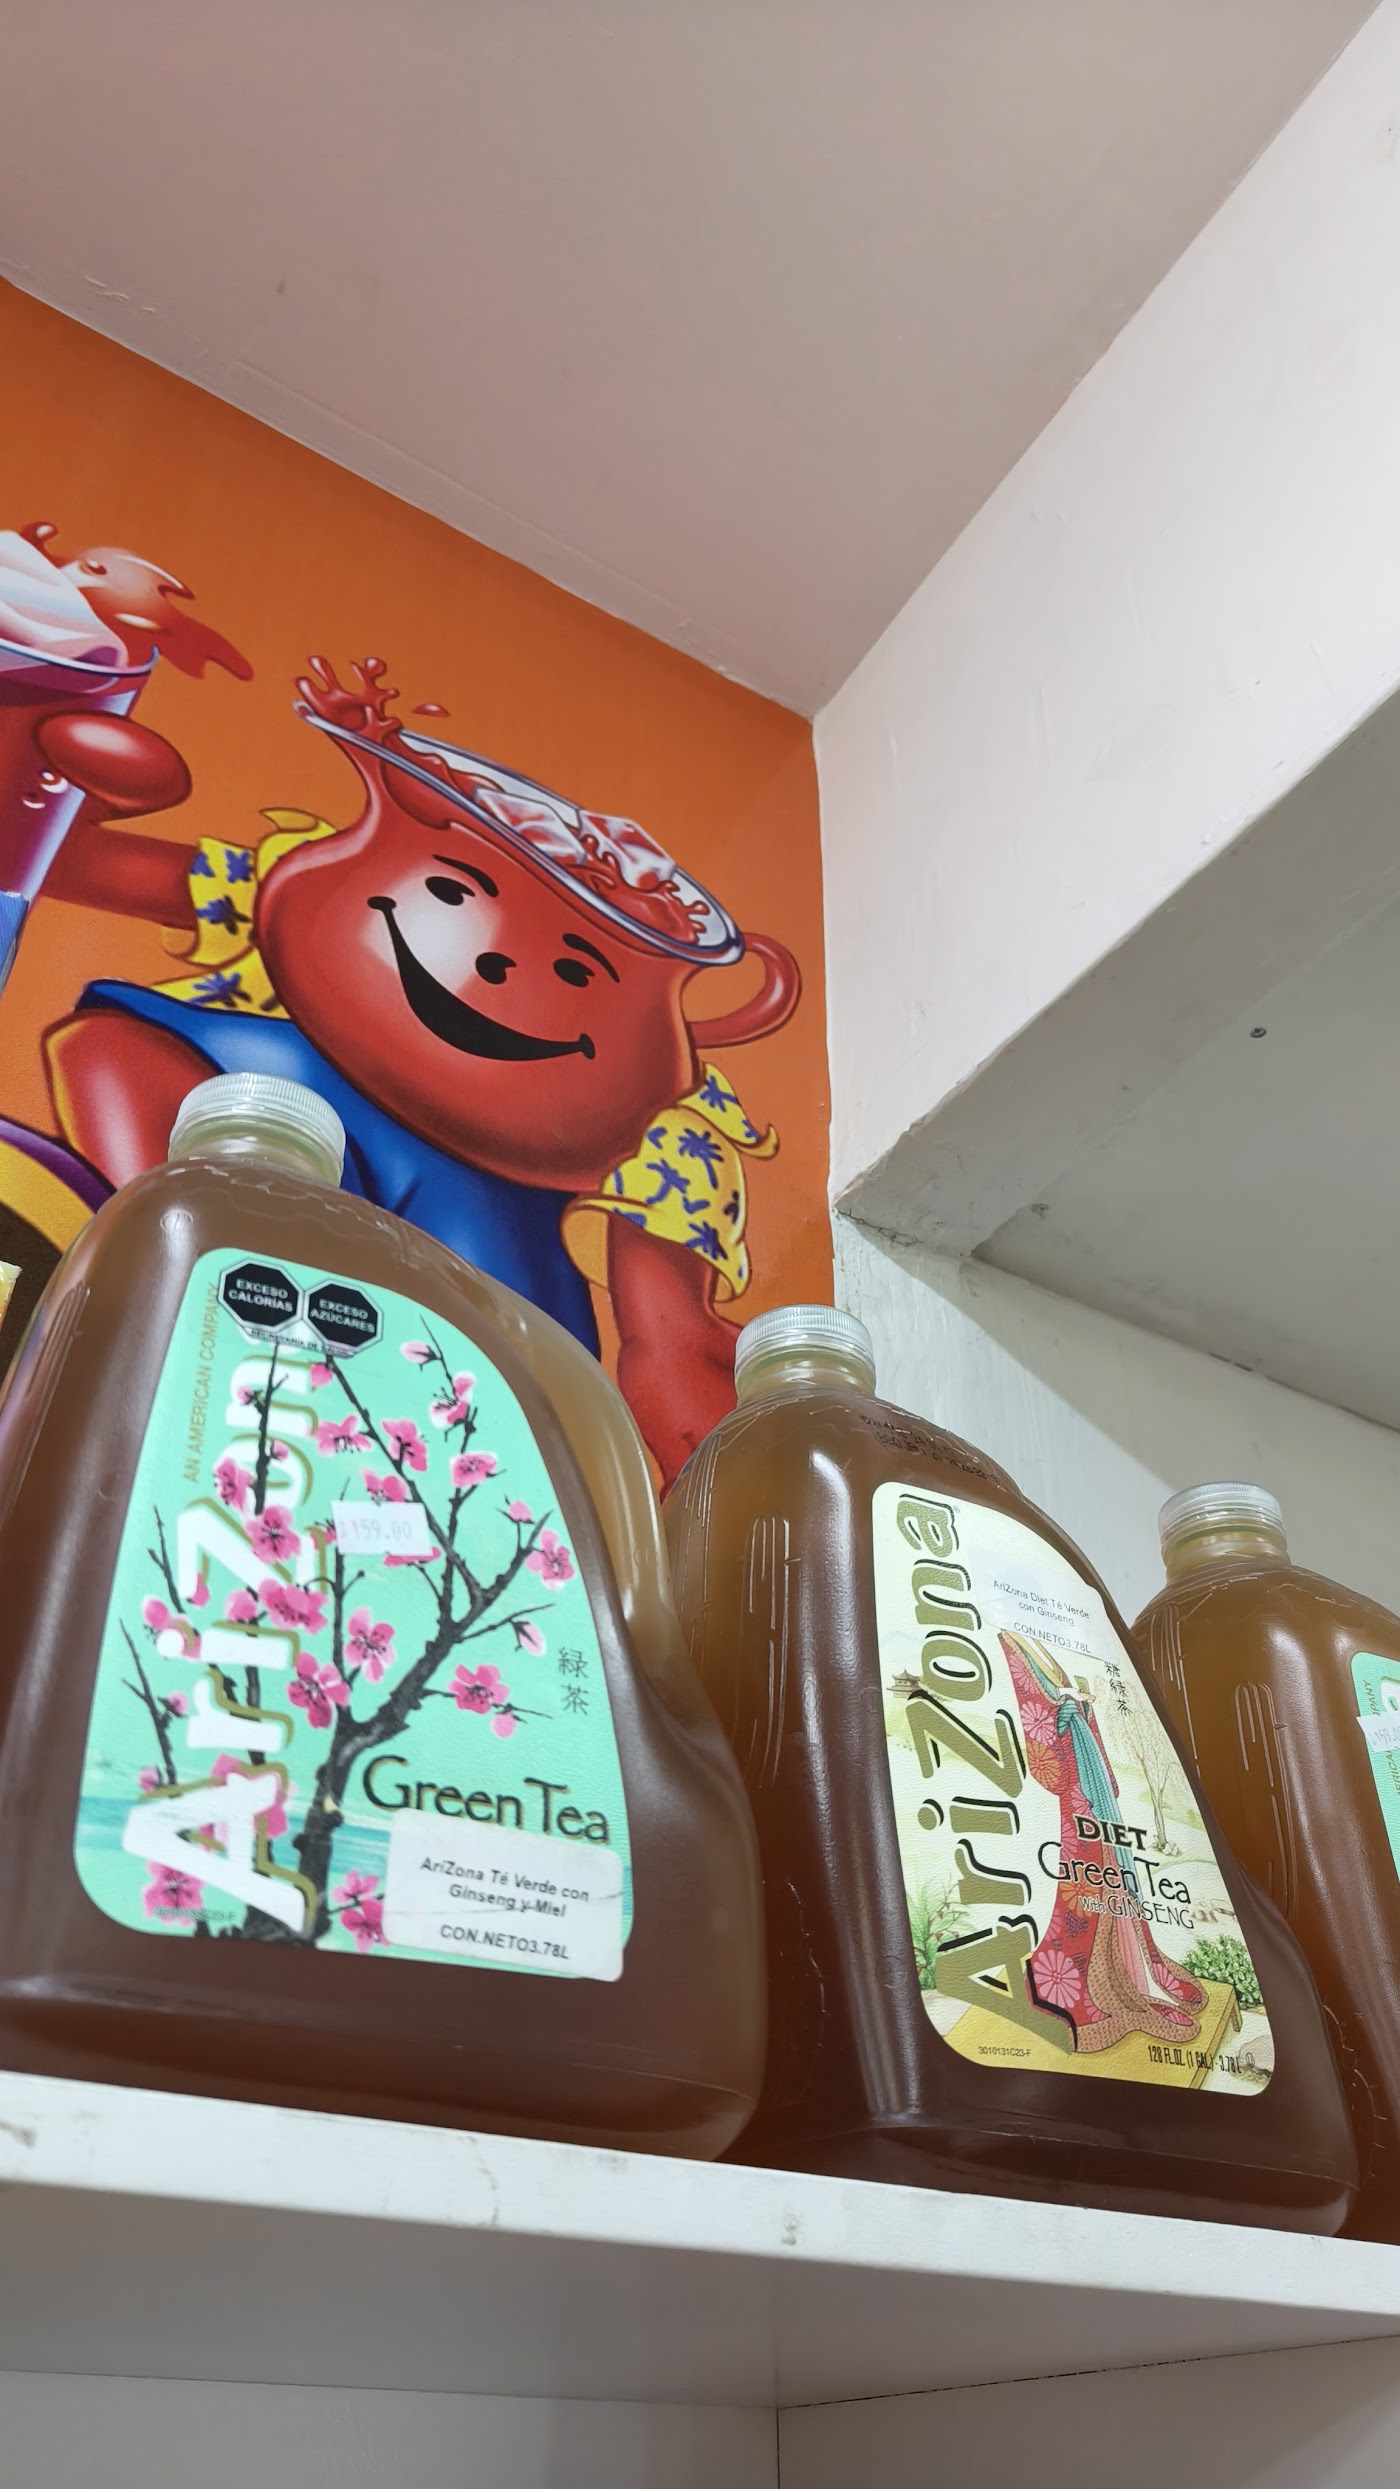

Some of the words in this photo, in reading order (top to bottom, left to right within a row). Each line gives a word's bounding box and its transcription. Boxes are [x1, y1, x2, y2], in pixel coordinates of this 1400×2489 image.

[228, 1289, 293, 1312] CALORÍAS
[236, 1279, 288, 1299] EXCESO
[199, 1282, 220, 1362] COMPANY
[310, 1308, 375, 1334] AZÚCARES
[319, 1299, 368, 1319] EXCESO
[188, 1367, 213, 1454] AMERICAN
[184, 1459, 201, 1483] AN
[993, 1580, 1028, 1599] AriZona
[1030, 1592, 1048, 1606] Diet
[1050, 1598, 1063, 1610] Té
[1064, 1602, 1090, 1619] Verde
[1018, 1601, 1035, 1612] con
[1037, 1606, 1075, 1627] Ginseng
[122, 1335, 320, 1936] AriZon
[1363, 1679, 1381, 1715] PANY
[894, 1493, 1078, 2056] AriZona
[363, 1755, 524, 1830] Green
[523, 1776, 610, 1846] Tea
[1073, 1814, 1147, 1850] DIET
[420, 1856, 485, 1882] AriZona
[490, 1868, 509, 1886] Té
[514, 1873, 557, 1895] Verde
[561, 1887, 590, 1902] con
[1038, 1841, 1139, 1894] Green
[1133, 1856, 1192, 1904] Tea
[449, 1884, 516, 1911] Ginseng
[520, 1900, 531, 1914] y
[535, 1901, 566, 1918] Miel
[1107, 1895, 1195, 1929] GINSENG
[440, 1924, 570, 1961] CON.NETO3.78L
[1148, 2045, 1162, 2063] 128
[1186, 2050, 1194, 2069] (1
